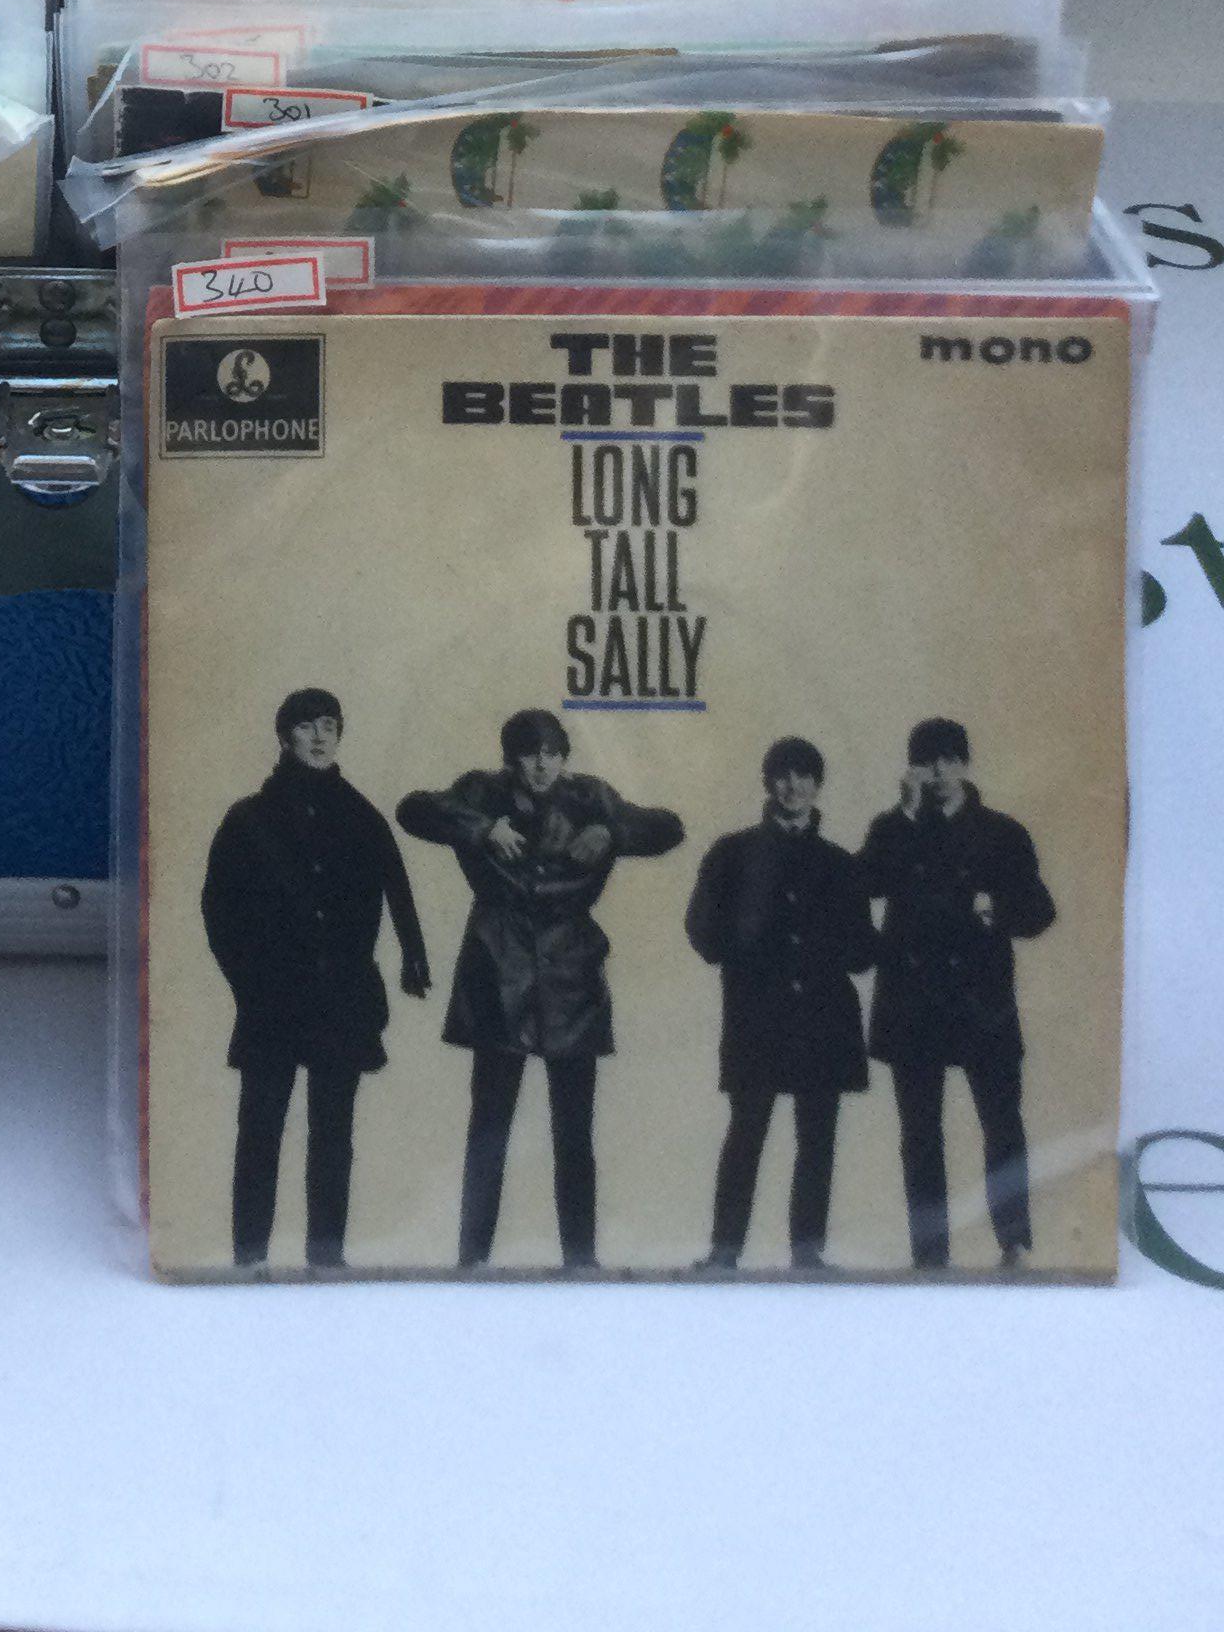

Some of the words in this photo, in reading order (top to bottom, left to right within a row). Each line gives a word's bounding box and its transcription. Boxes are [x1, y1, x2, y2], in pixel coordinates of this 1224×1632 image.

[180, 54, 240, 80] 302
[263, 98, 311, 121] 301
[201, 269, 274, 303] 340
[550, 333, 718, 376] THE
[919, 334, 1094, 366] mono
[442, 381, 836, 429] BEATLES
[166, 419, 319, 443] PARLOPHONE
[571, 444, 698, 527] LONG
[584, 529, 688, 612] TALL
[565, 616, 707, 698] SALLY
